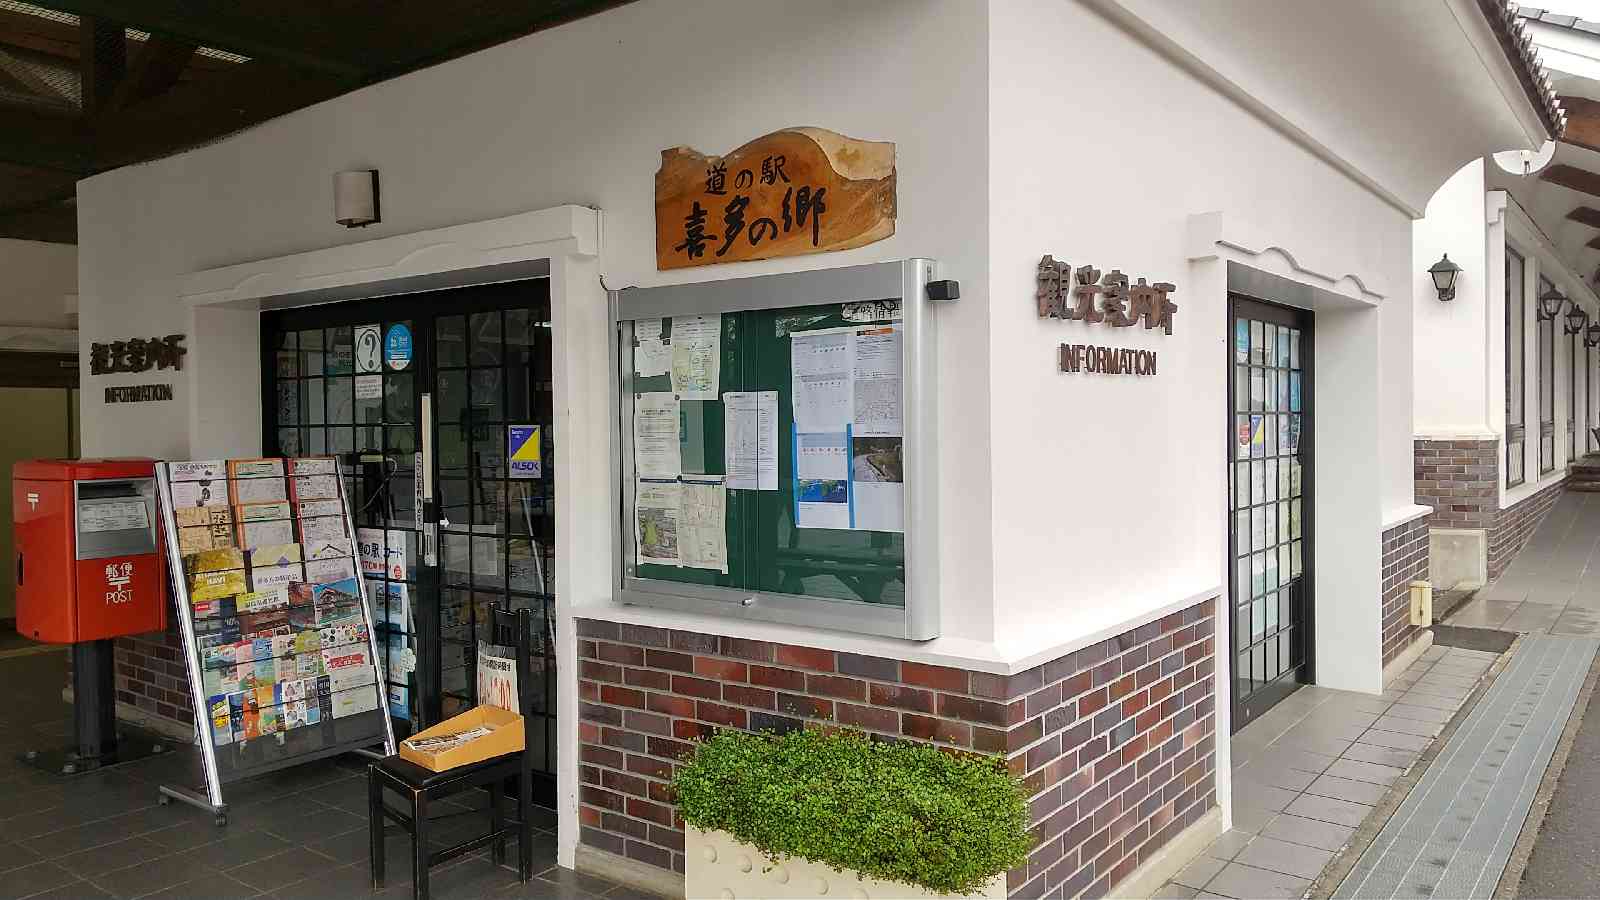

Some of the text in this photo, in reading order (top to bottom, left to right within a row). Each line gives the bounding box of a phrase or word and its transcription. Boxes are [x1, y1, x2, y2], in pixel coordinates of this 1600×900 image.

[704, 155, 791, 196] 道の駅
[674, 186, 827, 260] 喜多の郷
[1037, 254, 1178, 336] 観光案内所
[1058, 342, 1157, 376] INFORMATION
[104, 384, 173, 404] INFORMATION
[511, 461, 540, 471] ALSOK
[105, 562, 133, 579] 郵便
[105, 590, 133, 606] POST
